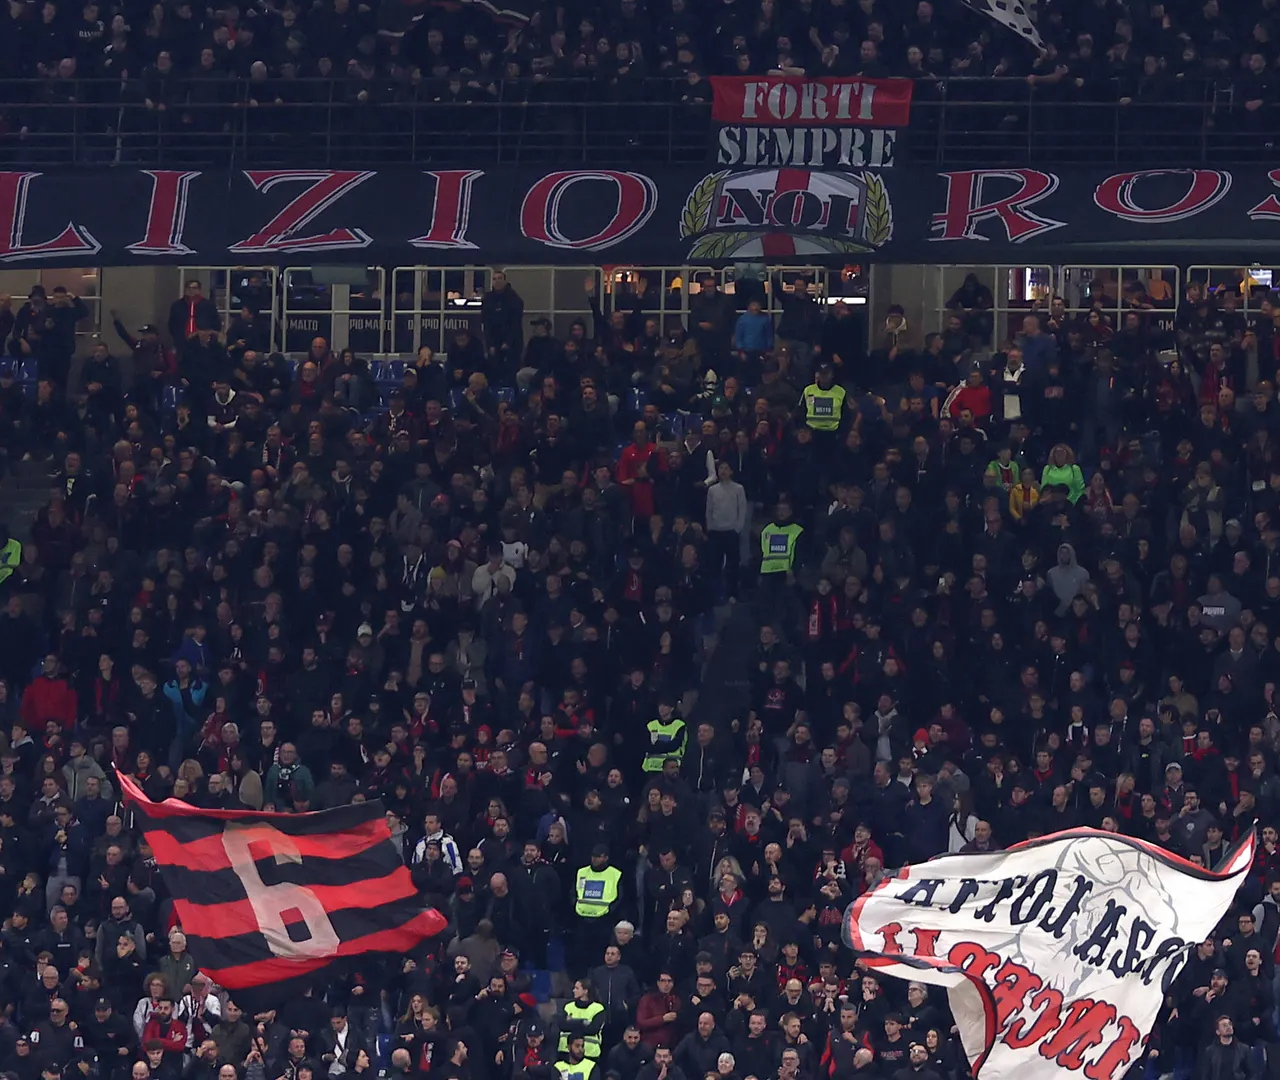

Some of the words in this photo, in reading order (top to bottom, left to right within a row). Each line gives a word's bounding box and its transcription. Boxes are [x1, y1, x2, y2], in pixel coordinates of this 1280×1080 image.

[741, 82, 877, 120] FORTI
[717, 126, 897, 168] SEMPRE
[717, 187, 854, 237] NOI
[289, 319, 319, 332] MALTO
[407, 318, 439, 331] DPPIO
[222, 820, 340, 962] 6
